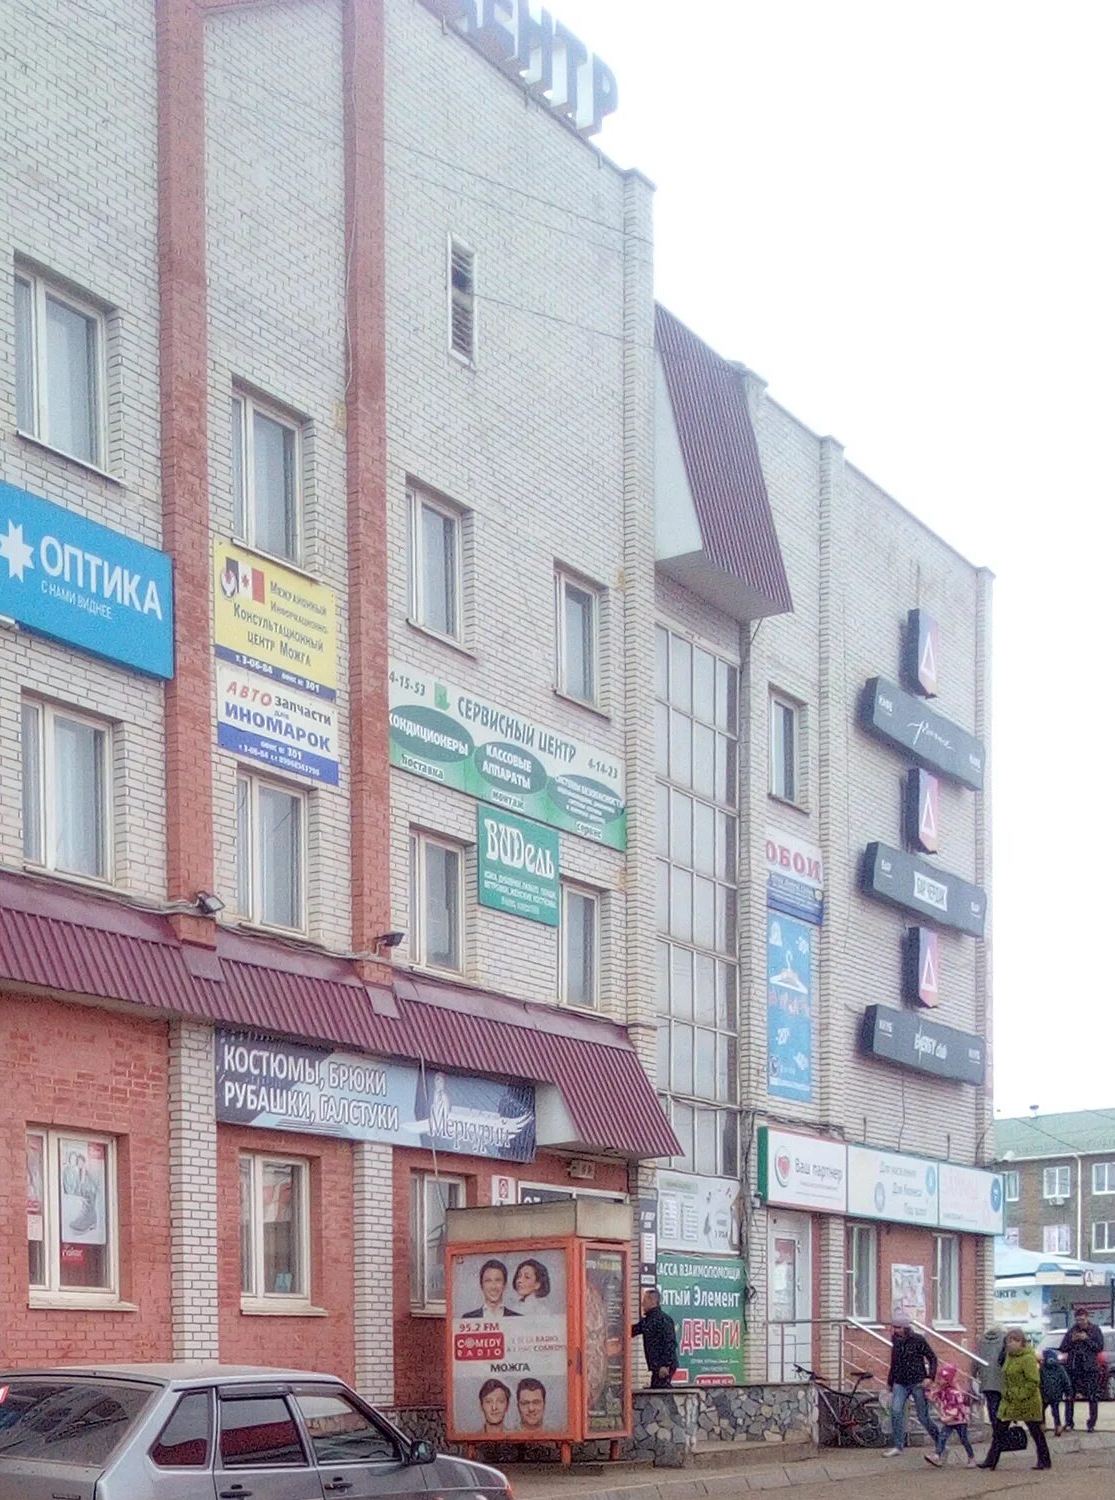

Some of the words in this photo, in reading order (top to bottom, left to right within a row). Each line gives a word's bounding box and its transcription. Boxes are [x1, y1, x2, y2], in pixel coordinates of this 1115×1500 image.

[39, 535, 163, 621] ОПТИКА
[41, 580, 49, 594] С
[49, 582, 76, 606] НАМИ
[76, 594, 113, 620] ВИДНЕЕ
[305, 678, 320, 694] 301
[225, 701, 331, 753] ИНОМАРОК
[389, 670, 426, 697] 4-15-53
[458, 695, 535, 748] СЕРВИСНЫЙ
[539, 731, 577, 764] ЦЕНТР
[587, 758, 618, 779] 4-14-23
[287, 747, 302, 760] 301
[486, 743, 532, 773] КАССОВЫЕ
[482, 760, 531, 790] АППАРАТЫ
[764, 838, 822, 884] ОБОИ
[223, 1044, 325, 1091] КОСТЮМЫ,
[328, 1062, 387, 1096] БРЮКИ
[224, 1080, 316, 1125] РУБАШКИ,
[319, 1093, 400, 1131] ГАЛСТУКИ
[428, 1100, 512, 1153] Меркурий
[794, 1157, 811, 1175] Ваш
[679, 1263, 741, 1282] ВЗАИМОПОМОЩИ
[693, 1285, 741, 1308] Элемент
[459, 1323, 481, 1332] 95.2
[483, 1322, 500, 1331] FM
[680, 1318, 741, 1356] ДЕНЬГИ
[489, 1362, 531, 1373] МОЖГА
